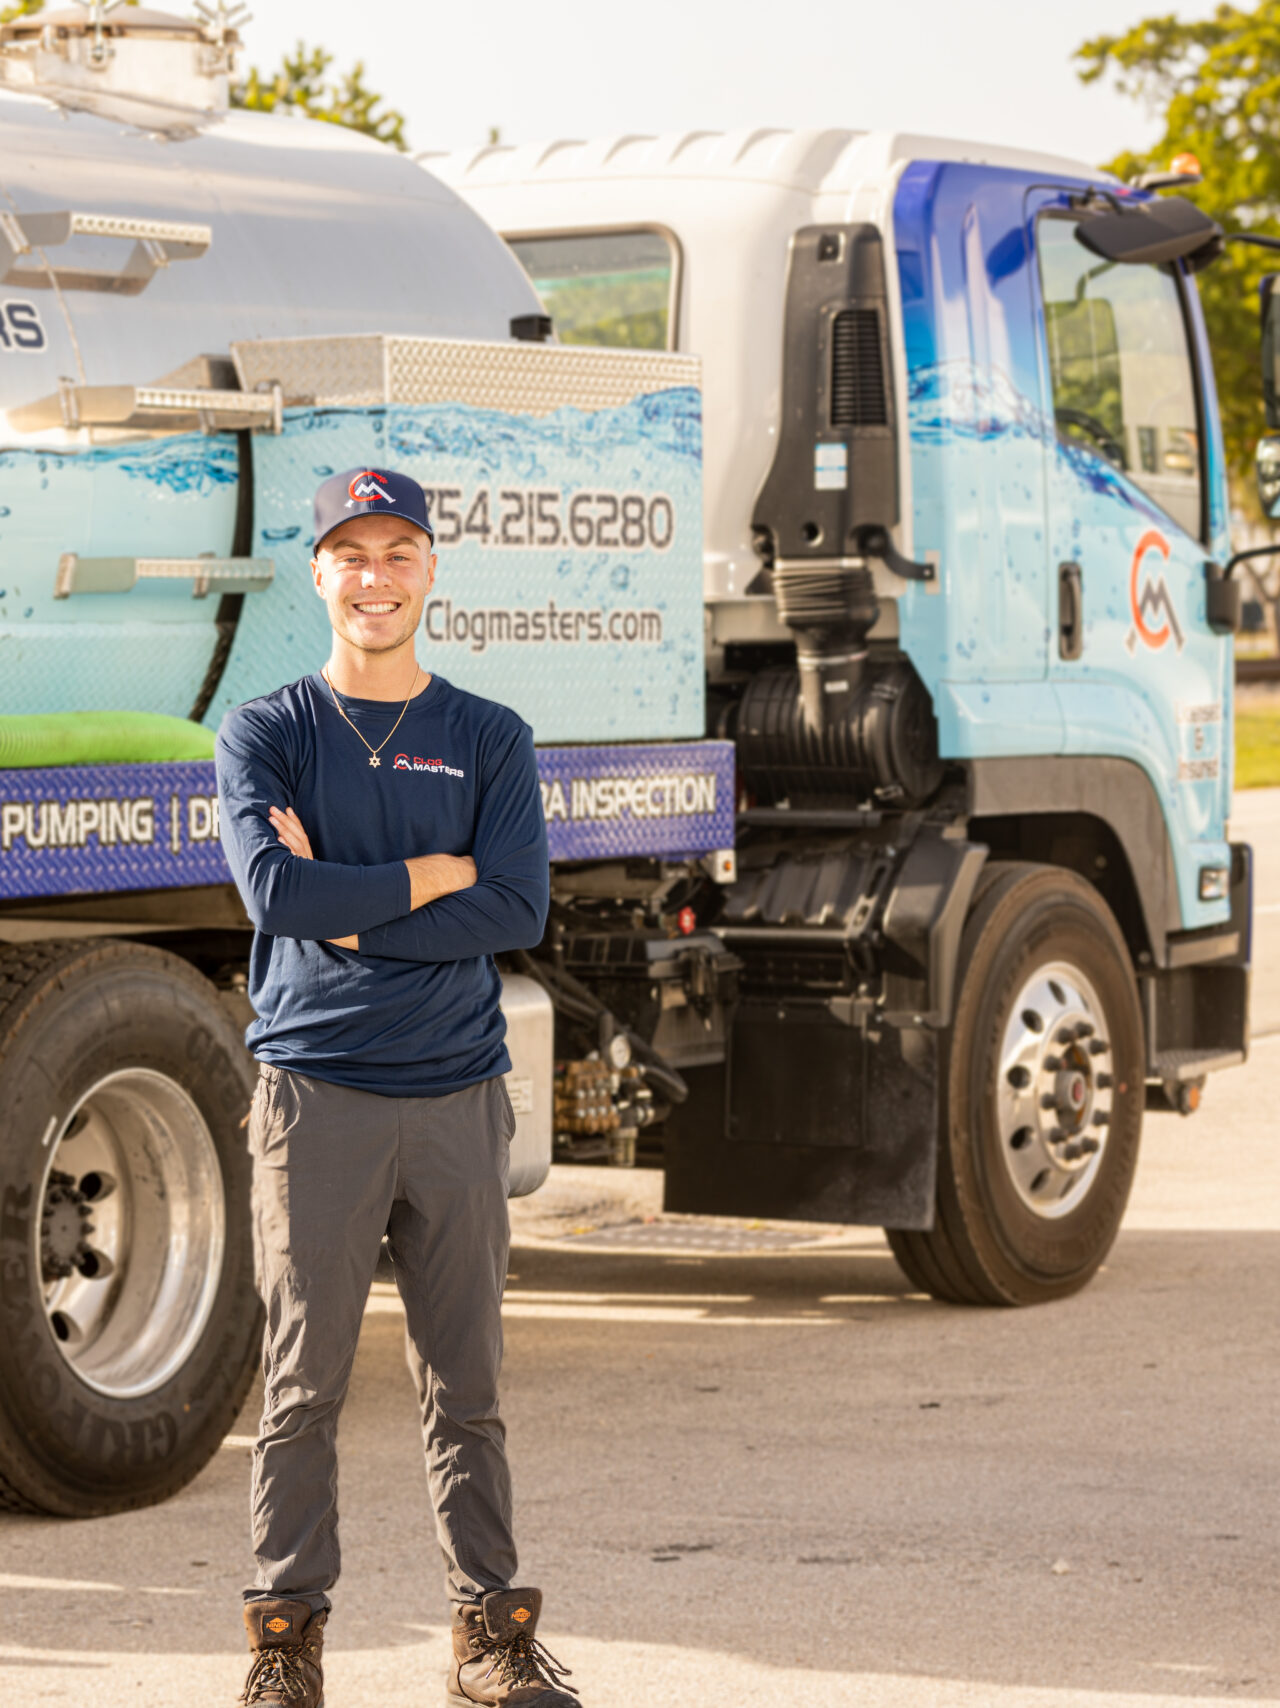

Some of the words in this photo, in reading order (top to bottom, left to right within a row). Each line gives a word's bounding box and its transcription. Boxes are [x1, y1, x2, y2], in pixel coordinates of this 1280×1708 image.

[425, 600, 662, 651] Clogmasters.com
[413, 756, 443, 766] CLOG
[413, 764, 465, 778] MASTERS
[2, 796, 154, 850] PUMPING
[572, 773, 717, 820] INSPECTION
